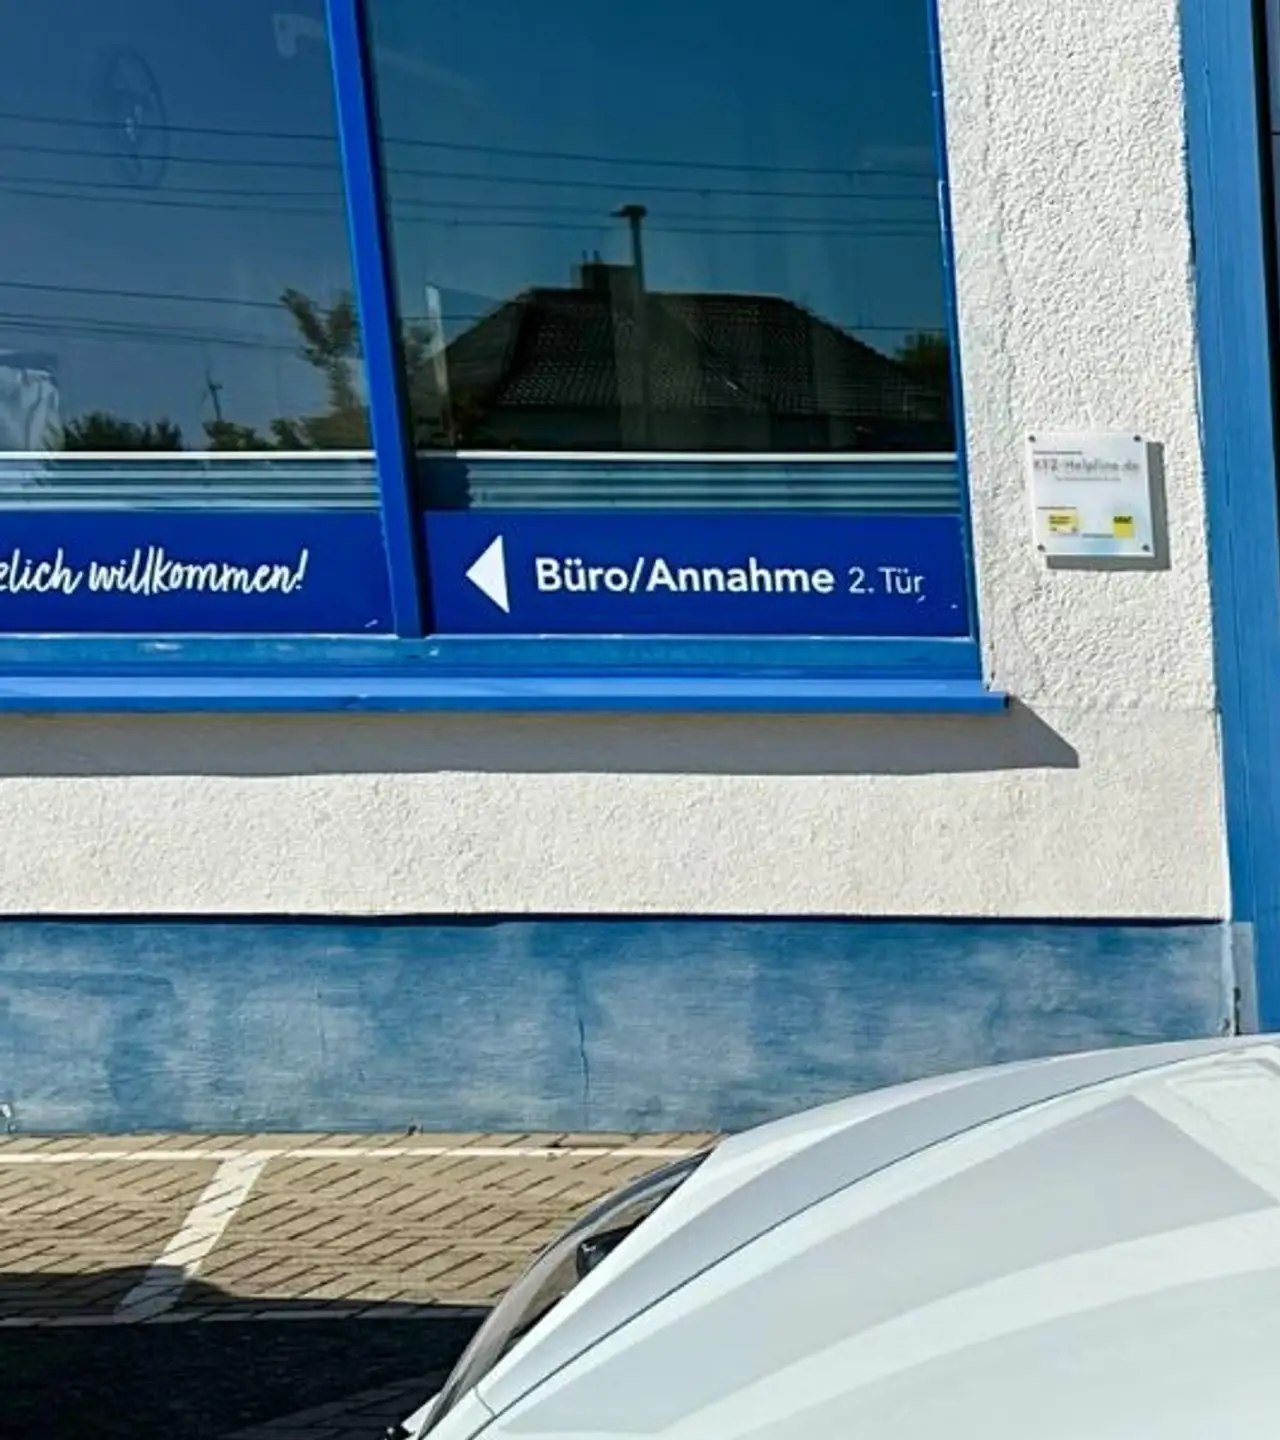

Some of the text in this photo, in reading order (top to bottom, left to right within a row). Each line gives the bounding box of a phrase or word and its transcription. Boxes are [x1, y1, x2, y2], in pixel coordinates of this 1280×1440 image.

[88, 545, 309, 596] willkommen!
[534, 557, 924, 595] Büro/Annahme 2. Tür
